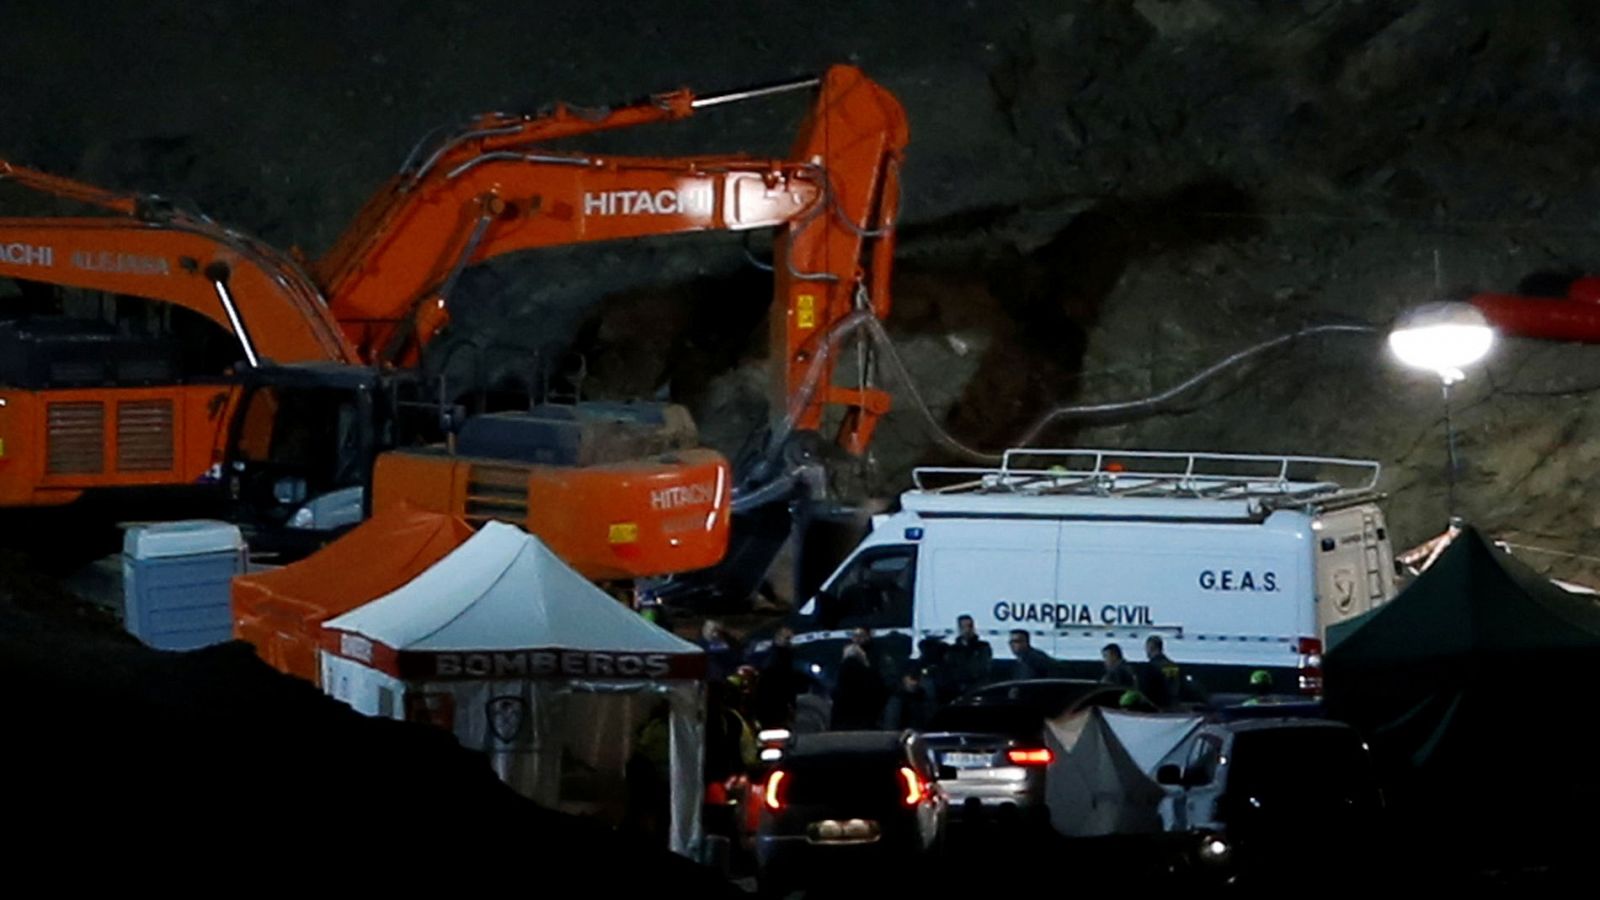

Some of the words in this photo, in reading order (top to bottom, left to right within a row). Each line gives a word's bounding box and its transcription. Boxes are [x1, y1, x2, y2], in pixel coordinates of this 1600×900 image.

[584, 190, 709, 216] HITACHI
[1199, 571, 1280, 592] G.E.A.S.
[993, 601, 1091, 625] GUARDIA
[1100, 604, 1153, 625] CIVIL
[435, 652, 670, 677] BOMBEROS
